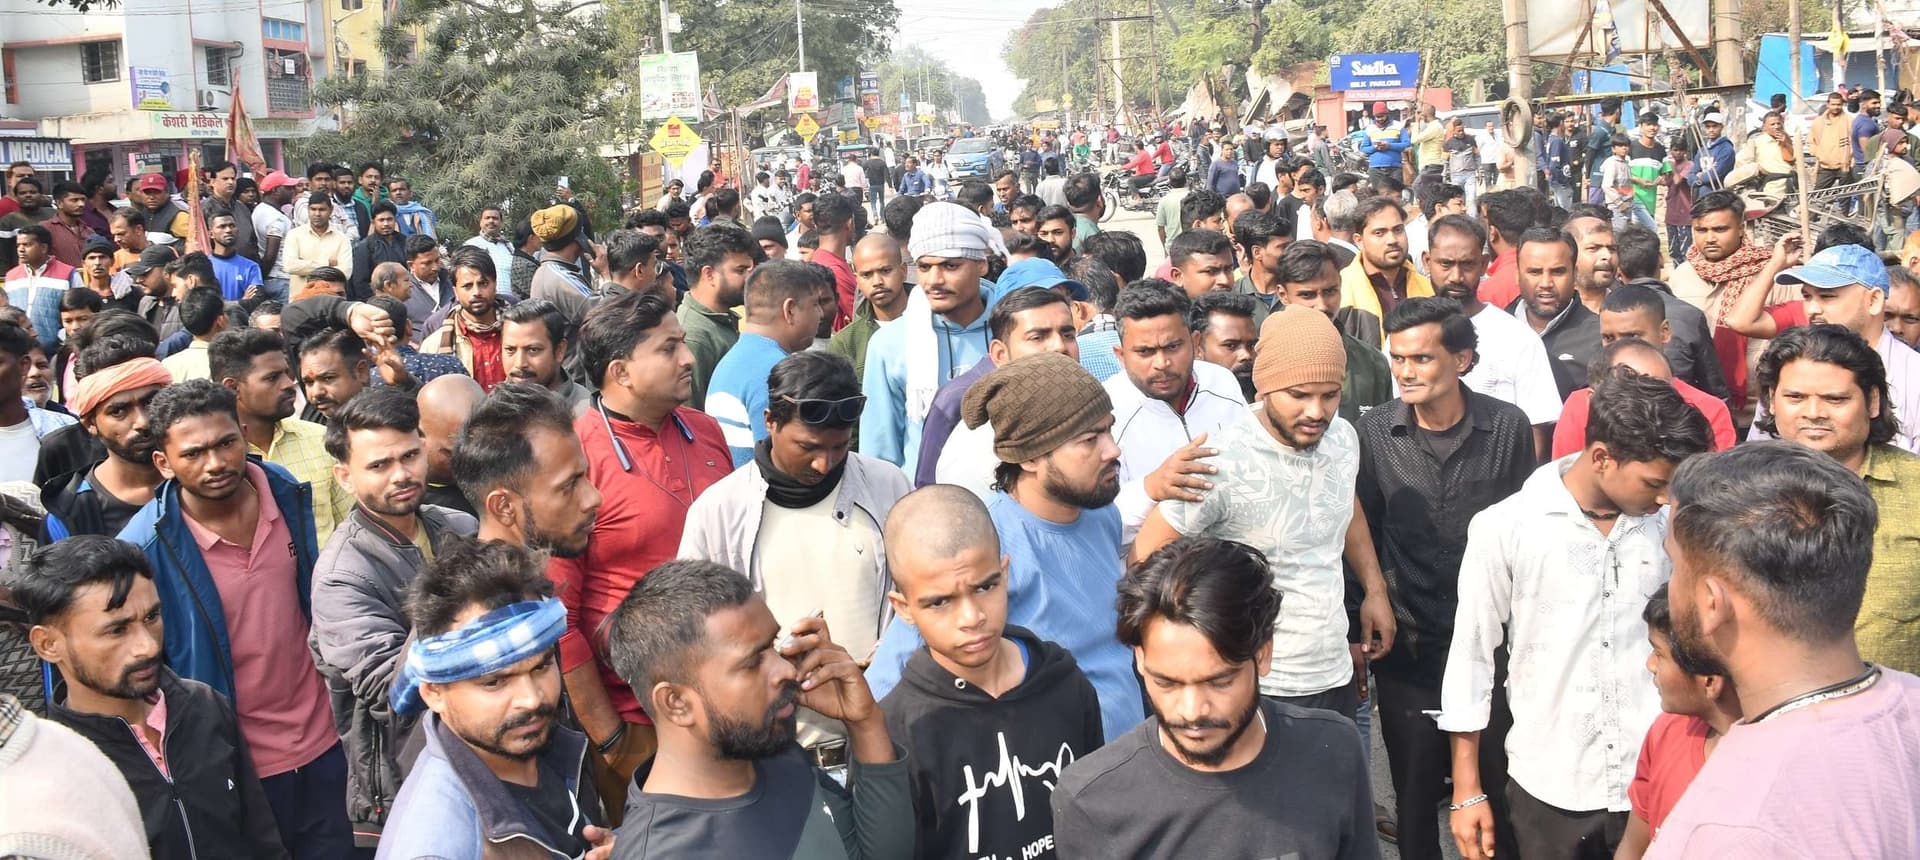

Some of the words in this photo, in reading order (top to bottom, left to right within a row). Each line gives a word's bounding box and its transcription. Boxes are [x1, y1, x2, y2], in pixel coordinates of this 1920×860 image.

[161, 113, 187, 128] केशरी
[8, 141, 71, 163] MEDICAL
[1022, 834, 1054, 860] HOPE
